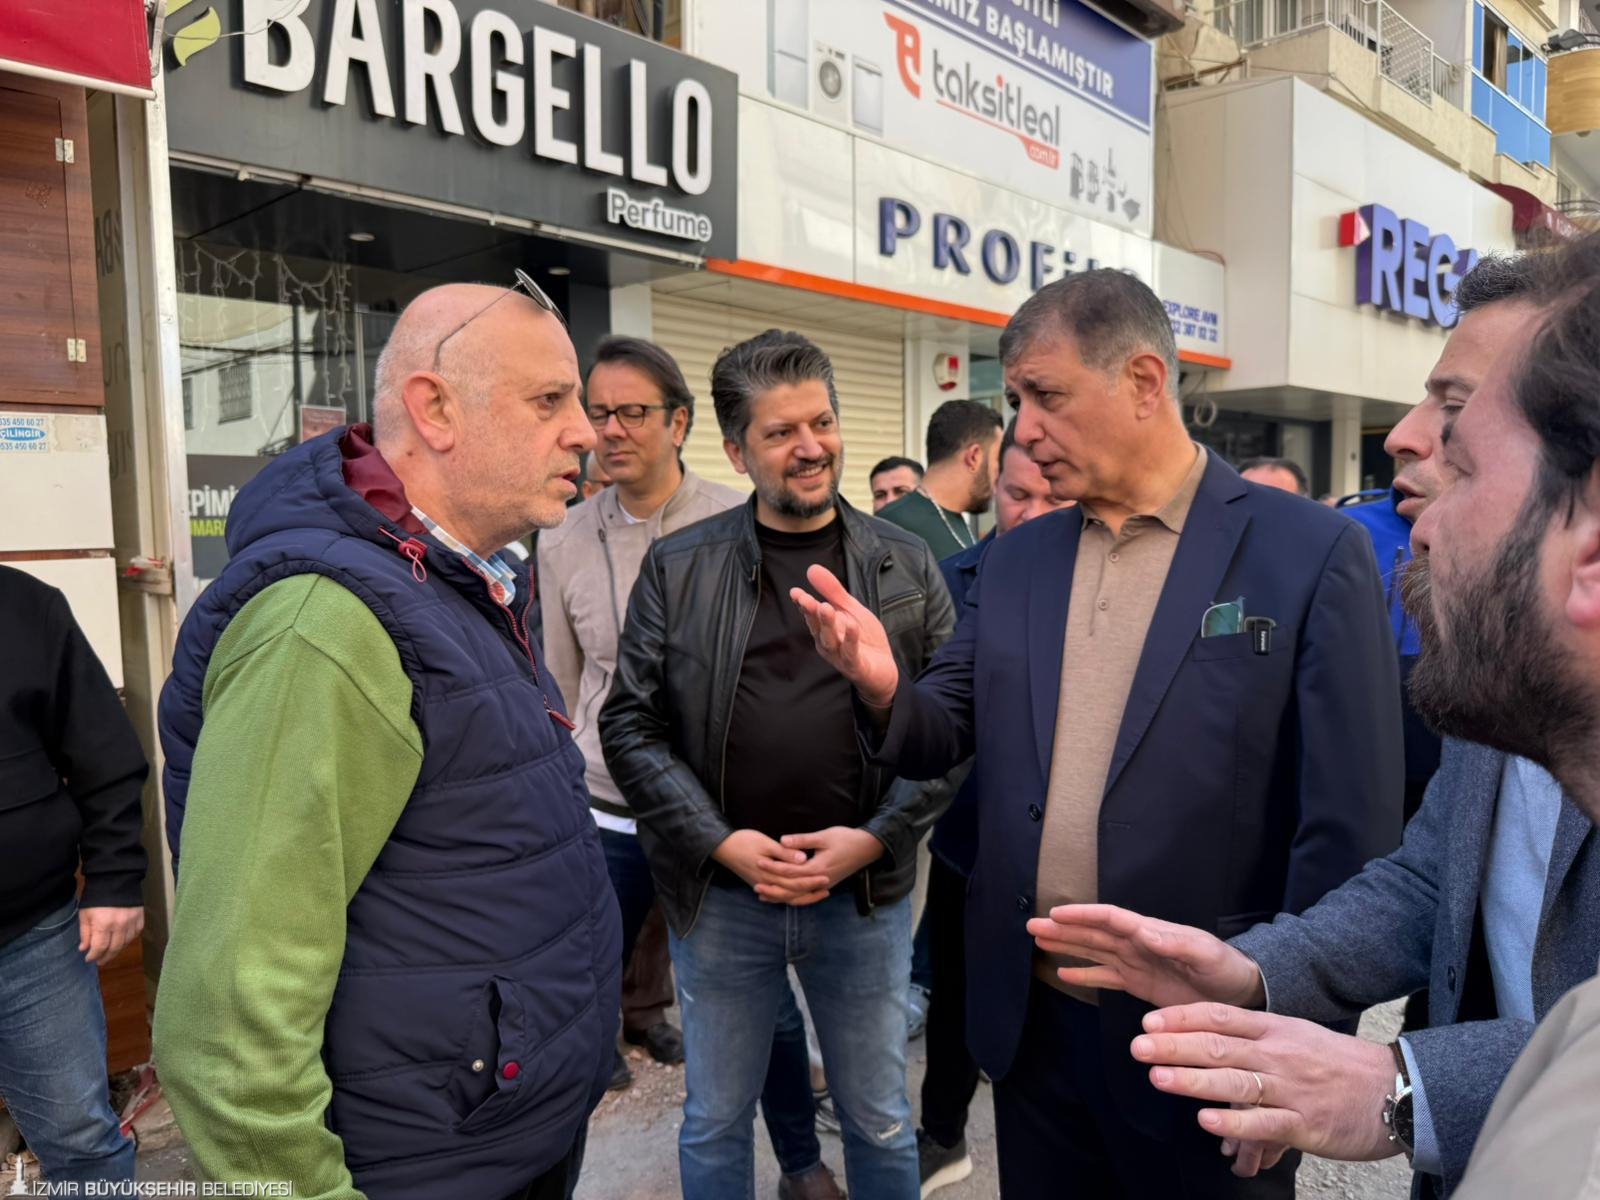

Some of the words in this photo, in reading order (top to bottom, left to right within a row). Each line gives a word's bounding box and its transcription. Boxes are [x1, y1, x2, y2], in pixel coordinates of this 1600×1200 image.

[243, 0, 713, 196] BARGELLO
[932, 48, 1060, 147] taksitleal
[985, 5, 1114, 99] BAŞLAMIŞTIR
[606, 187, 712, 243] Perfume
